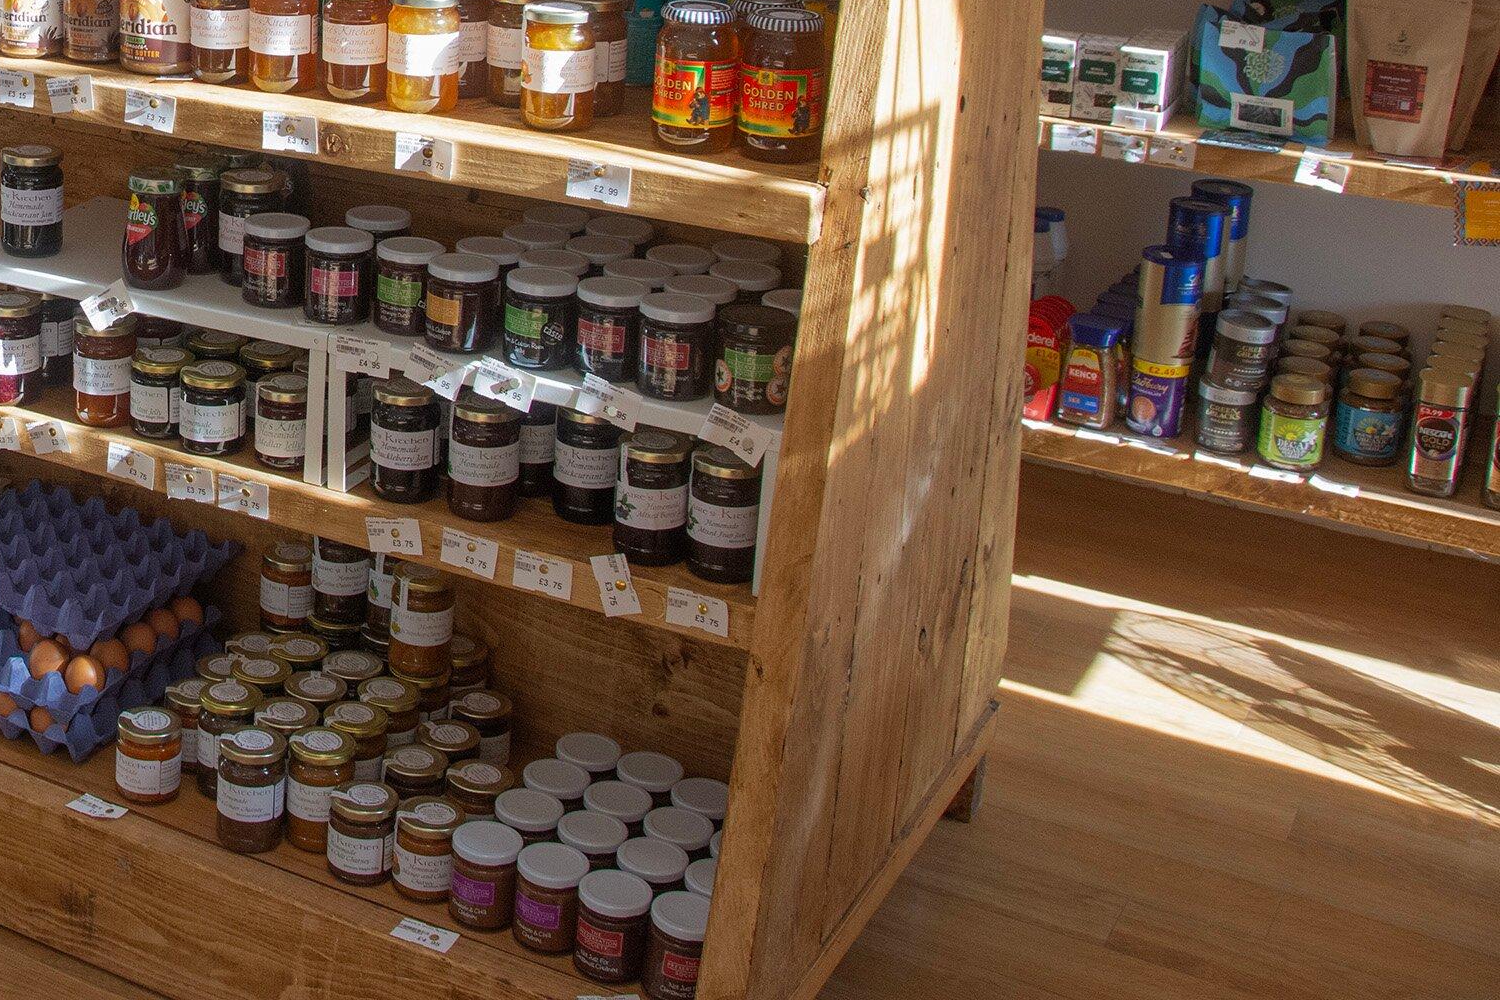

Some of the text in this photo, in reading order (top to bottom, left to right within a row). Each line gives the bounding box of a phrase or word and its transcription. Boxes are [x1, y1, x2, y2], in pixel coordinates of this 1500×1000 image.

[120, 17, 178, 36] eridian
[261, 14, 300, 28] Kitchen
[341, 24, 376, 37] Kitchen
[134, 50, 160, 58] BUTTER
[7, 91, 27, 99] £3.15
[743, 82, 794, 101] GOLDEN
[749, 98, 785, 111] SHRED
[146, 112, 167, 124] £3.75
[287, 137, 310, 146] £3.75
[422, 159, 444, 170] £3.75
[593, 184, 619, 197] £2.99
[7, 201, 44, 210] Homemade
[358, 359, 381, 370] £4.95
[1069, 367, 1098, 380] KENCO
[1149, 367, 1176, 376] £2.49
[1133, 375, 1169, 394] Cadbury
[192, 404, 236, 418] Kitchen
[1420, 407, 1444, 416] £3.99
[385, 431, 430, 445] Kitchen
[1421, 436, 1449, 446] GOLD
[458, 458, 501, 469] Homemade
[566, 459, 609, 471] Homemade
[129, 467, 148, 481] £3.75
[186, 485, 207, 496] £3.75
[239, 499, 260, 510] £3.75
[392, 539, 414, 548] £3.75
[465, 556, 487, 569] £3.75
[538, 577, 563, 591] £3.75
[604, 581, 618, 607] £3.75
[694, 615, 720, 628] £3.75
